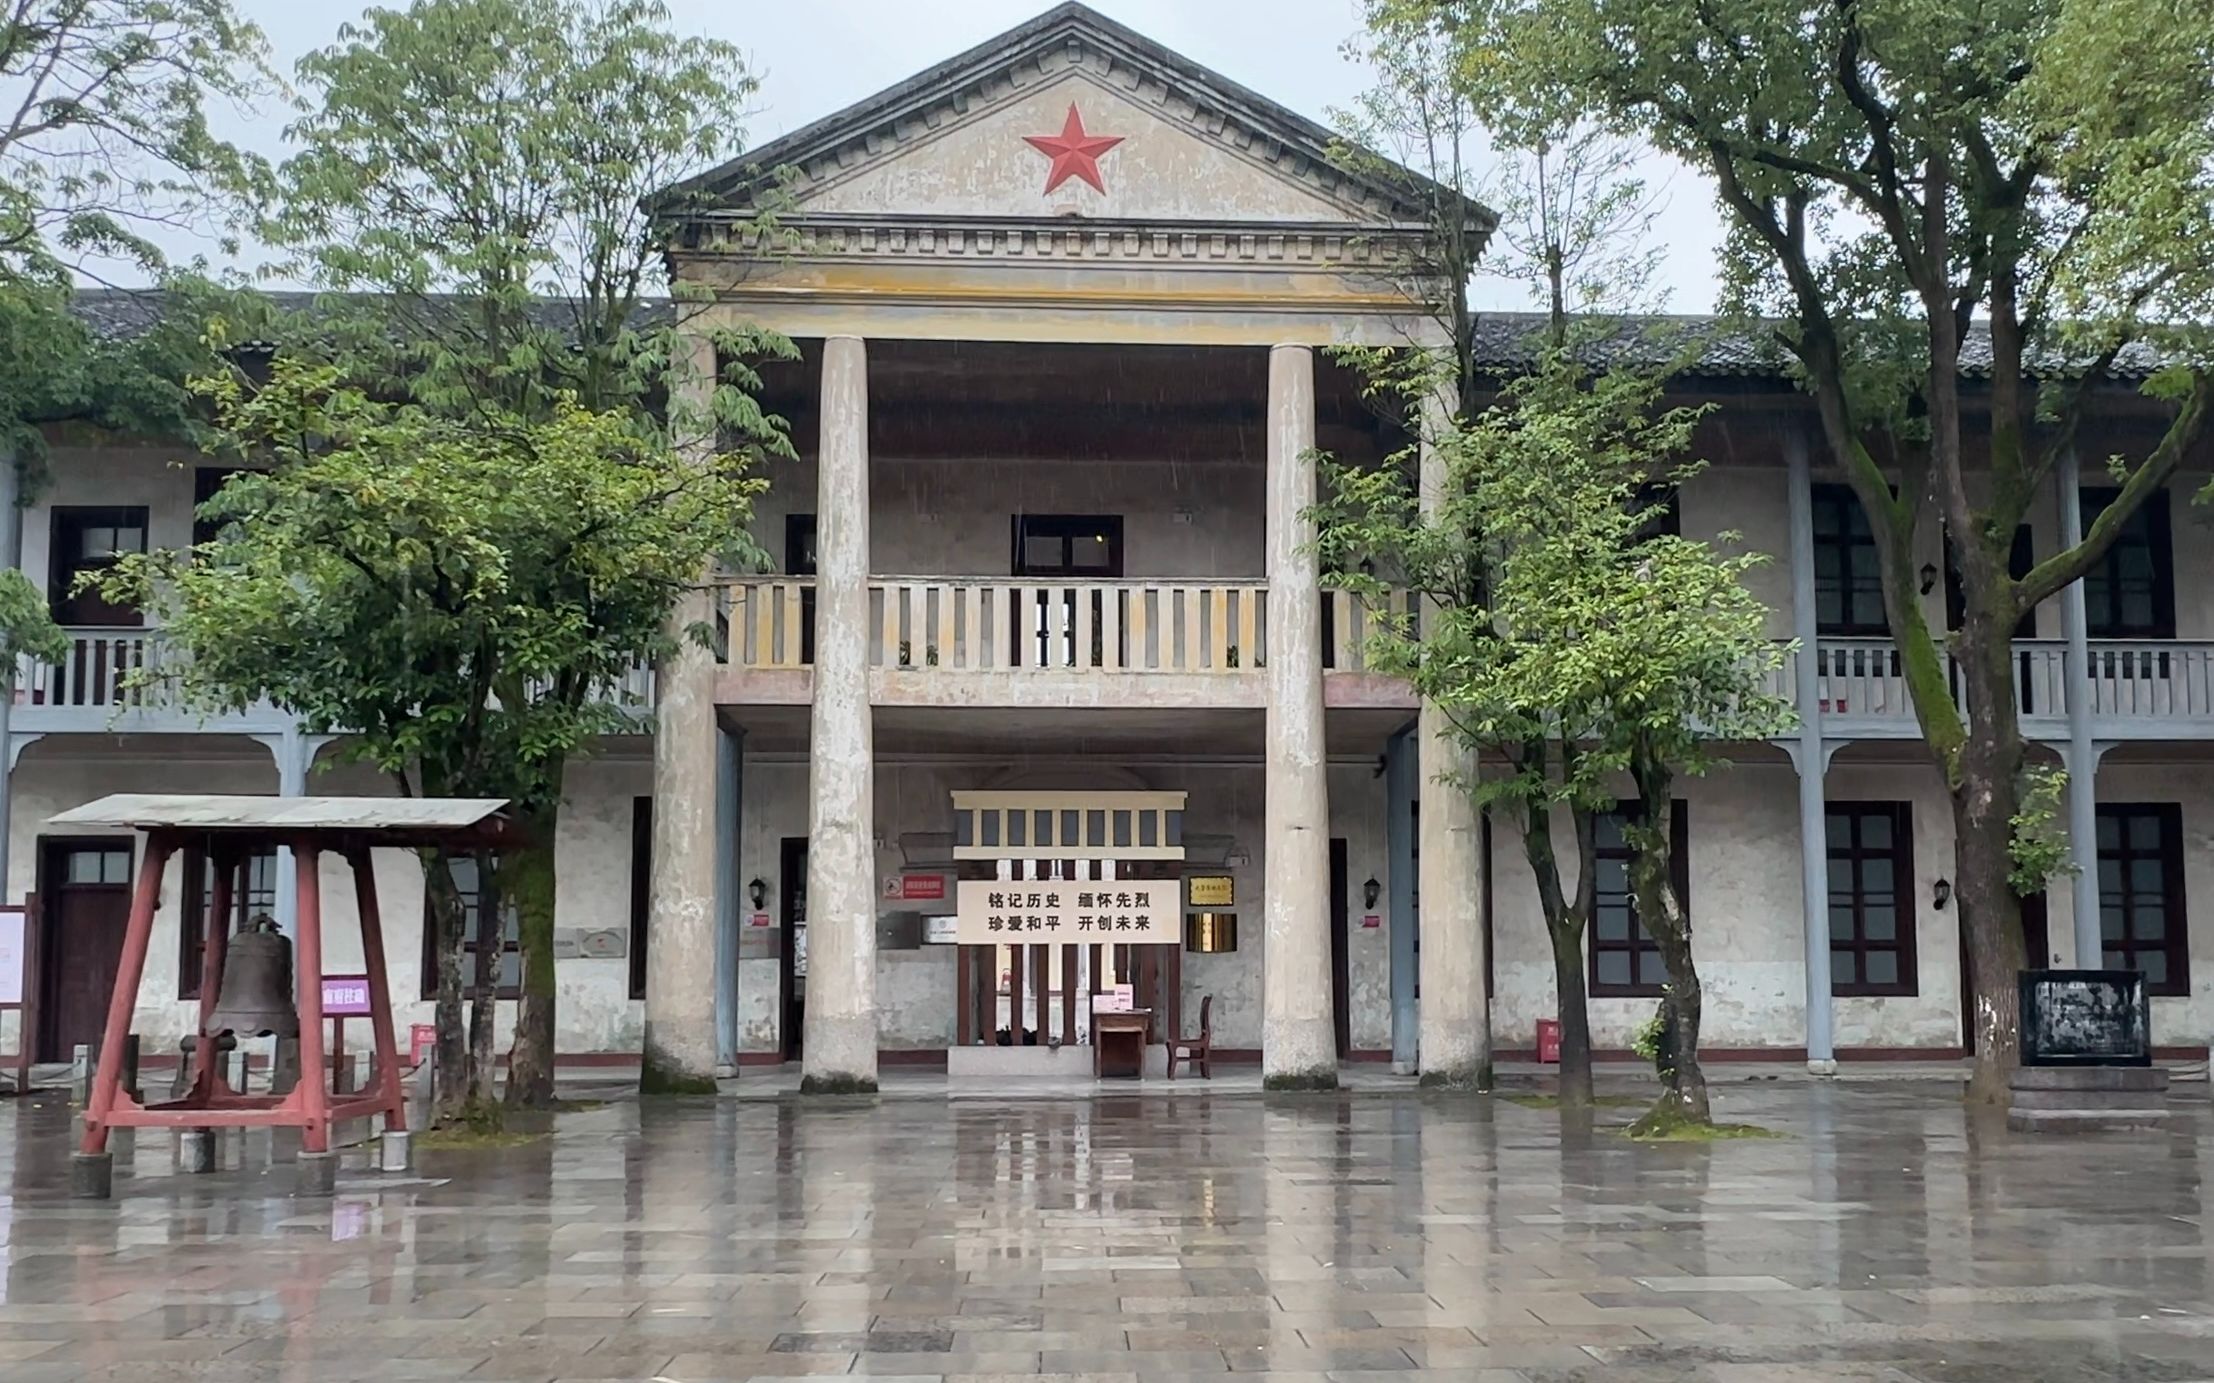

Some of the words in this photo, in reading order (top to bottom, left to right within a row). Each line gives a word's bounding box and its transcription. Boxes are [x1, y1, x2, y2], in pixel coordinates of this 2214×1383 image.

[988, 892, 1061, 908] 铭记历史
[1078, 892, 1150, 908] 缅怀先烈
[988, 915, 1061, 931] 珍爱和平
[1078, 915, 1150, 931] 开创未来
